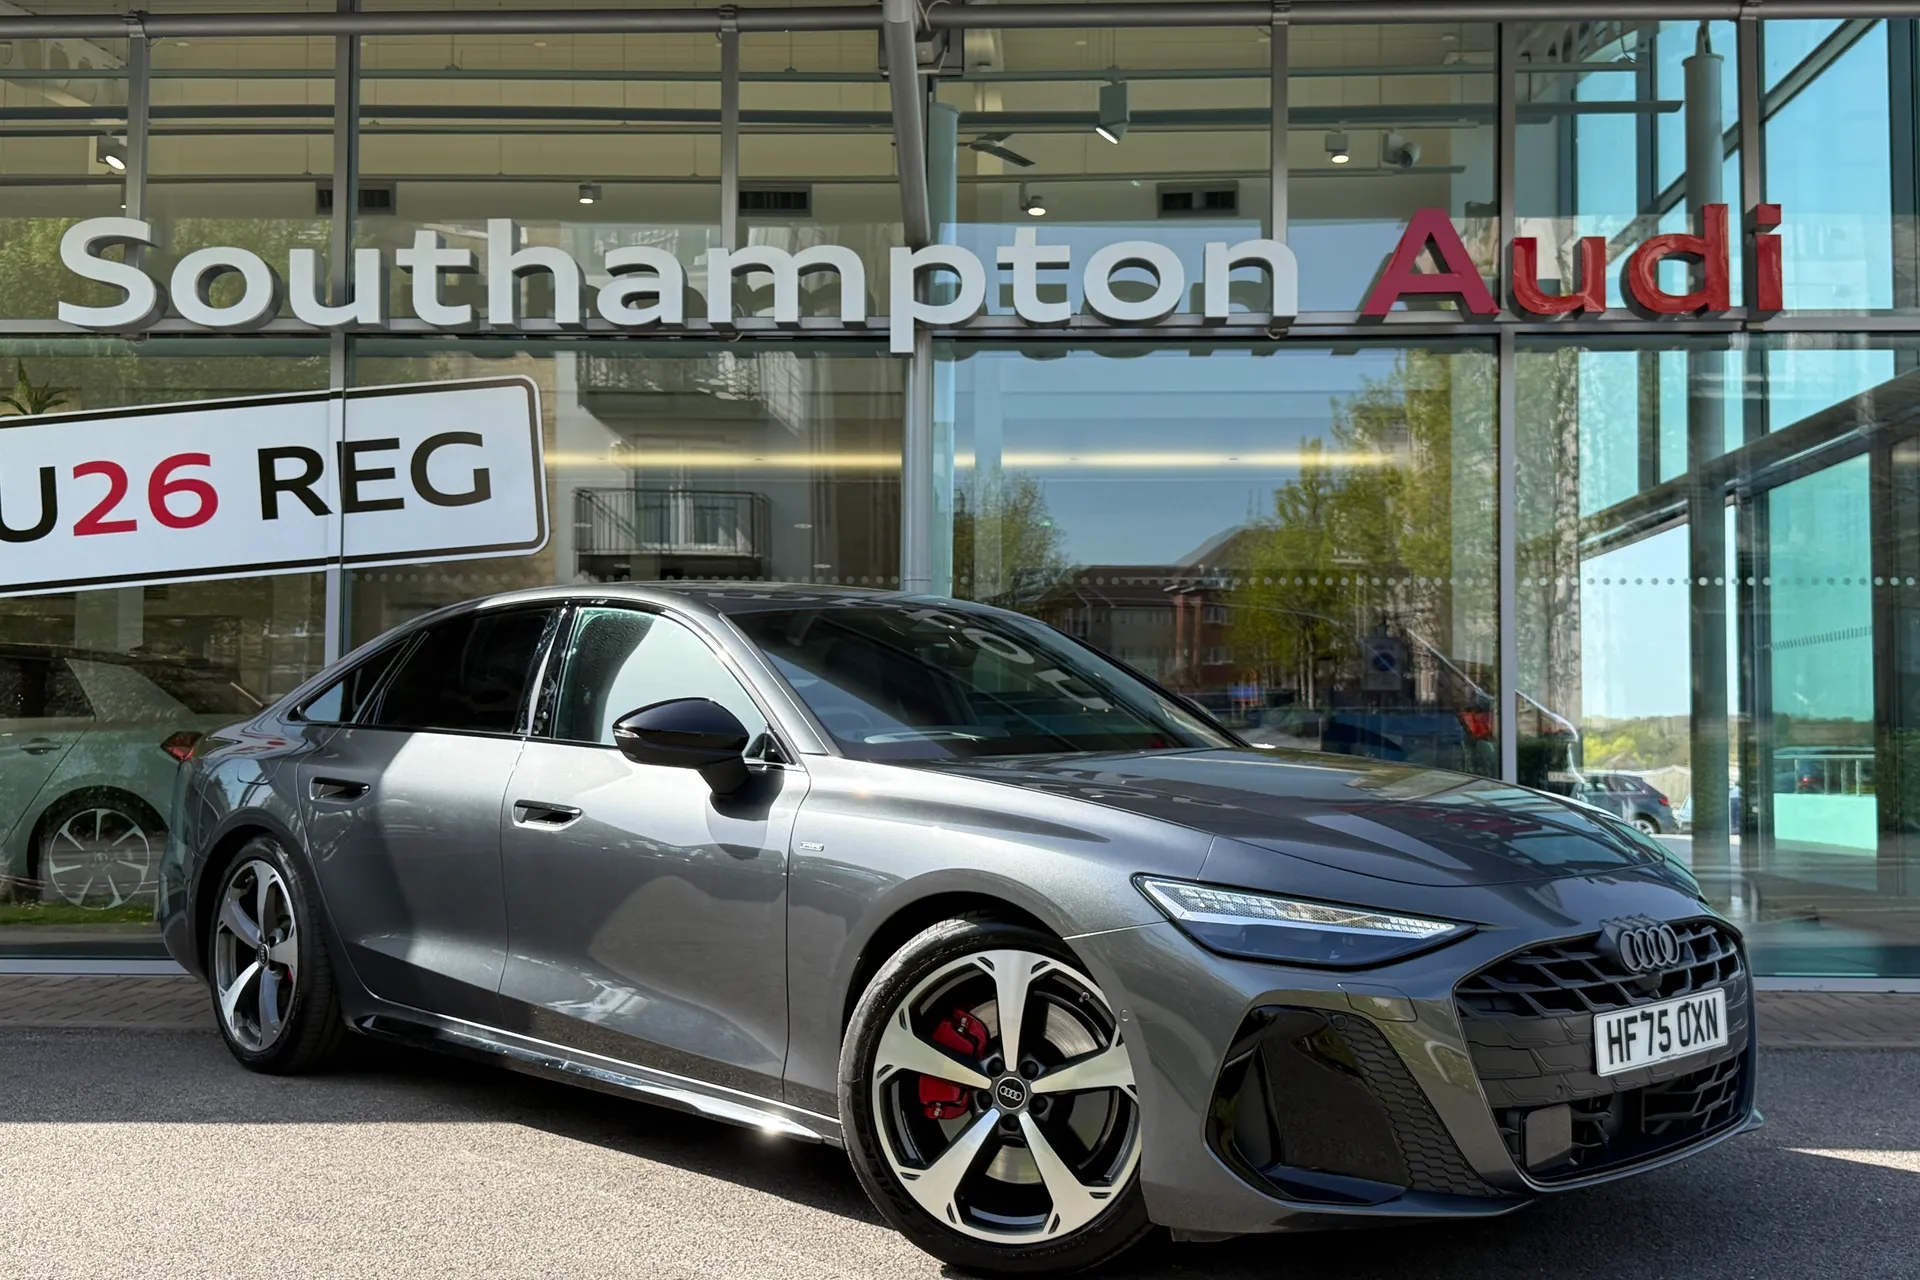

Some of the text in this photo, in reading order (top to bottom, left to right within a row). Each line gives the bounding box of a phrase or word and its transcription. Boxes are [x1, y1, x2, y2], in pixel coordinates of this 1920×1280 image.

[57, 203, 1784, 355] Southampton Audi
[257, 431, 492, 521] REG
[1606, 997, 1719, 1065] HF75 OXN
